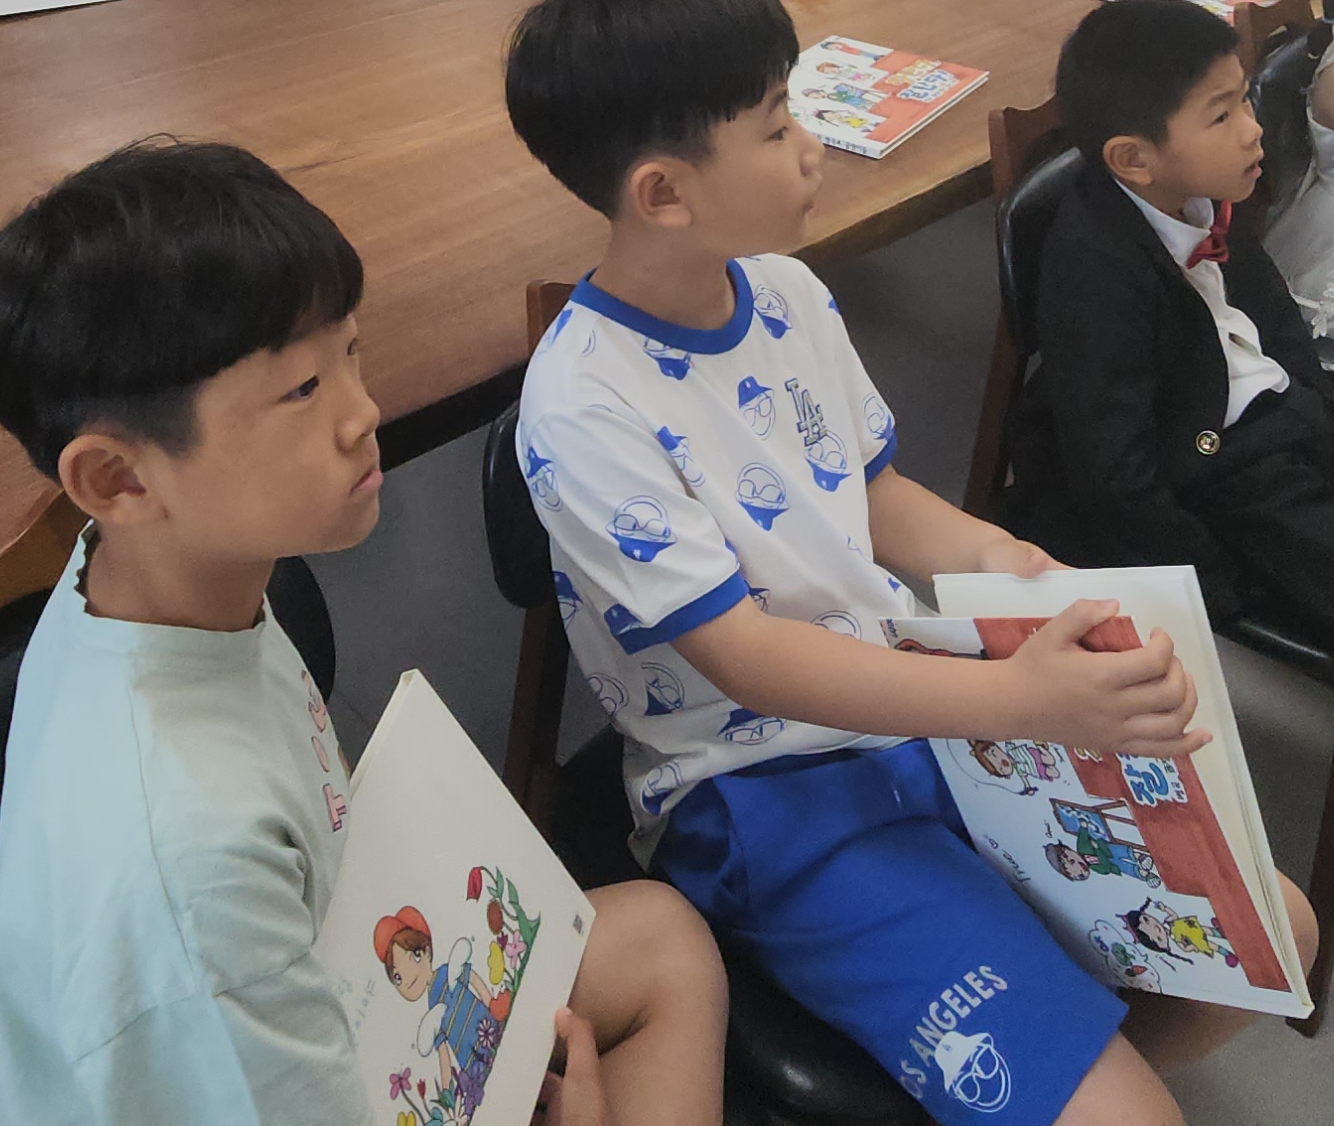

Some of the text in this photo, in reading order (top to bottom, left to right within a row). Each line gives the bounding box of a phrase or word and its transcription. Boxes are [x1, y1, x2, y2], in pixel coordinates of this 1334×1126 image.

[785, 377, 826, 447] LA
[898, 965, 1008, 1100] OS ANGELES
